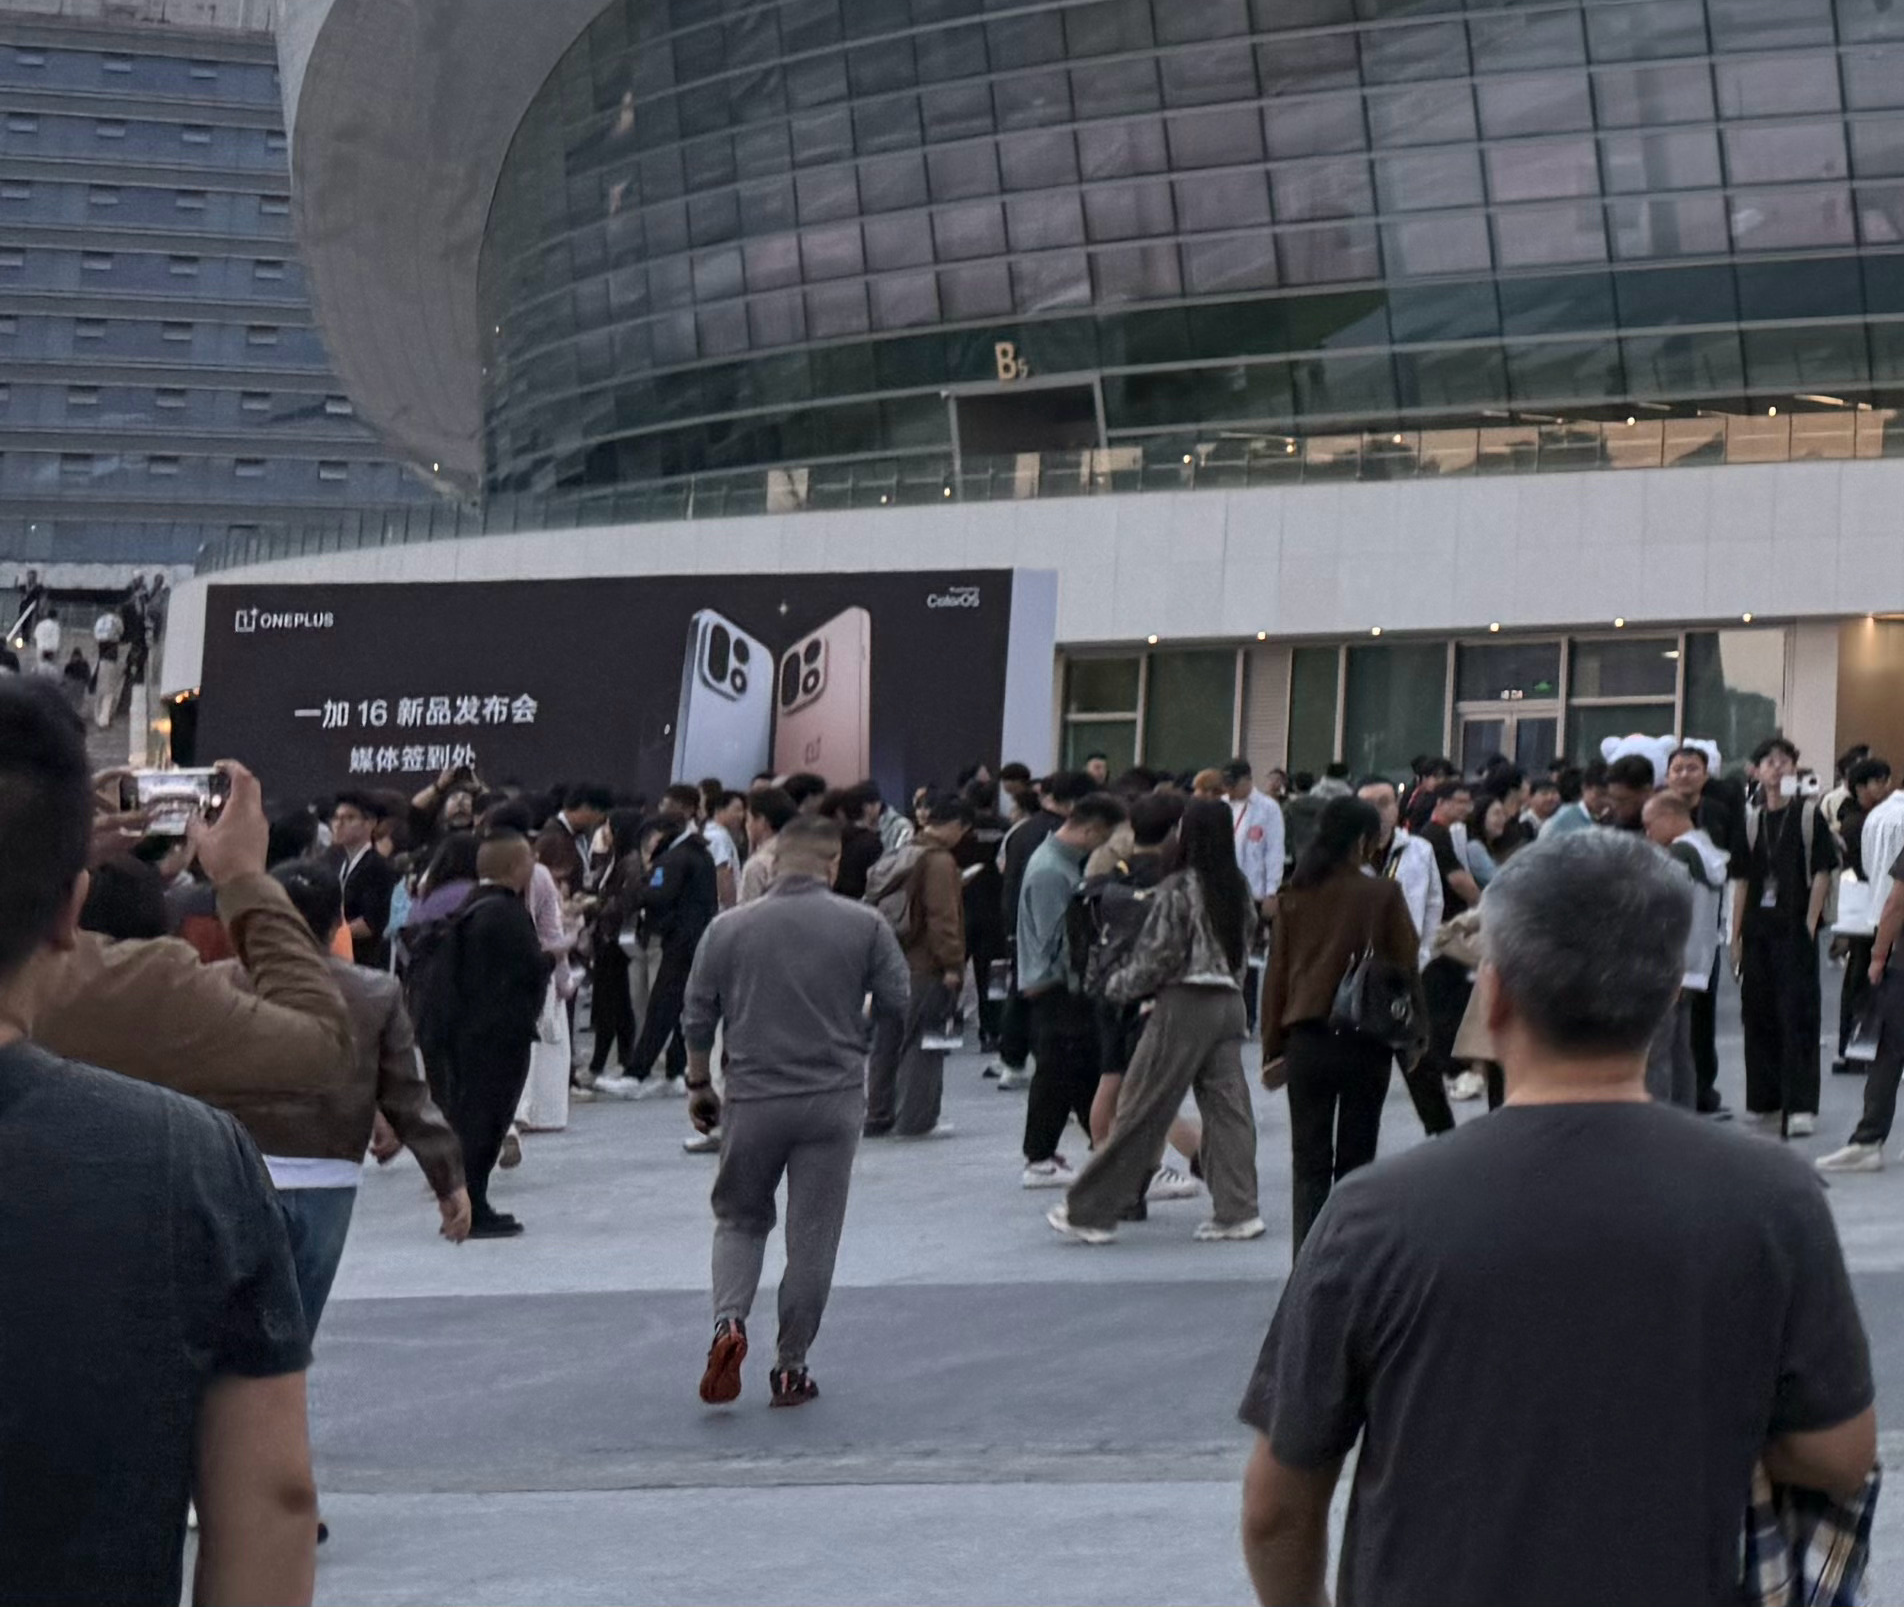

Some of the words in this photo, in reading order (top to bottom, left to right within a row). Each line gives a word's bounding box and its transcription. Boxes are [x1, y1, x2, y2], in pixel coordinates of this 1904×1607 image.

[294, 698, 350, 728] 一加
[357, 698, 388, 727] 16
[397, 693, 539, 727] 新品发布会
